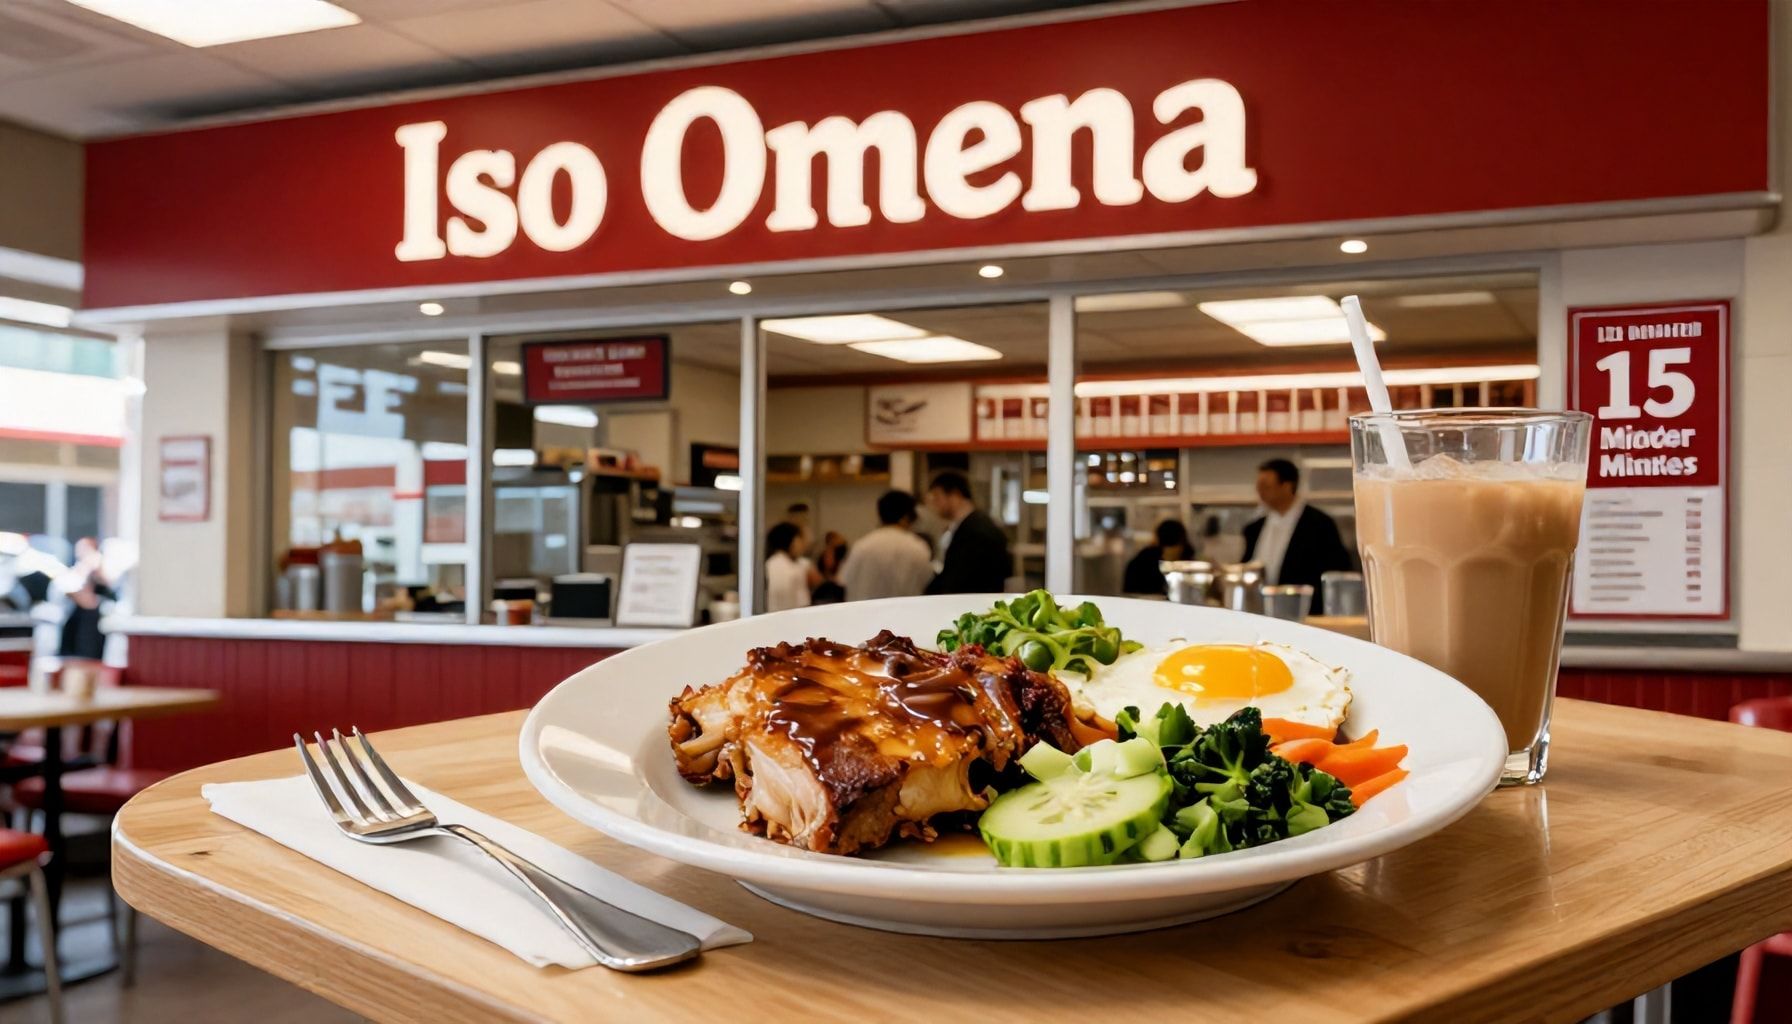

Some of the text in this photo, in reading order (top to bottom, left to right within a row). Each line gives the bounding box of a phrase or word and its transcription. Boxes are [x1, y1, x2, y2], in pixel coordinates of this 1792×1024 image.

[395, 79, 1257, 262] Iso Omena
[1596, 347, 1695, 419] 15
